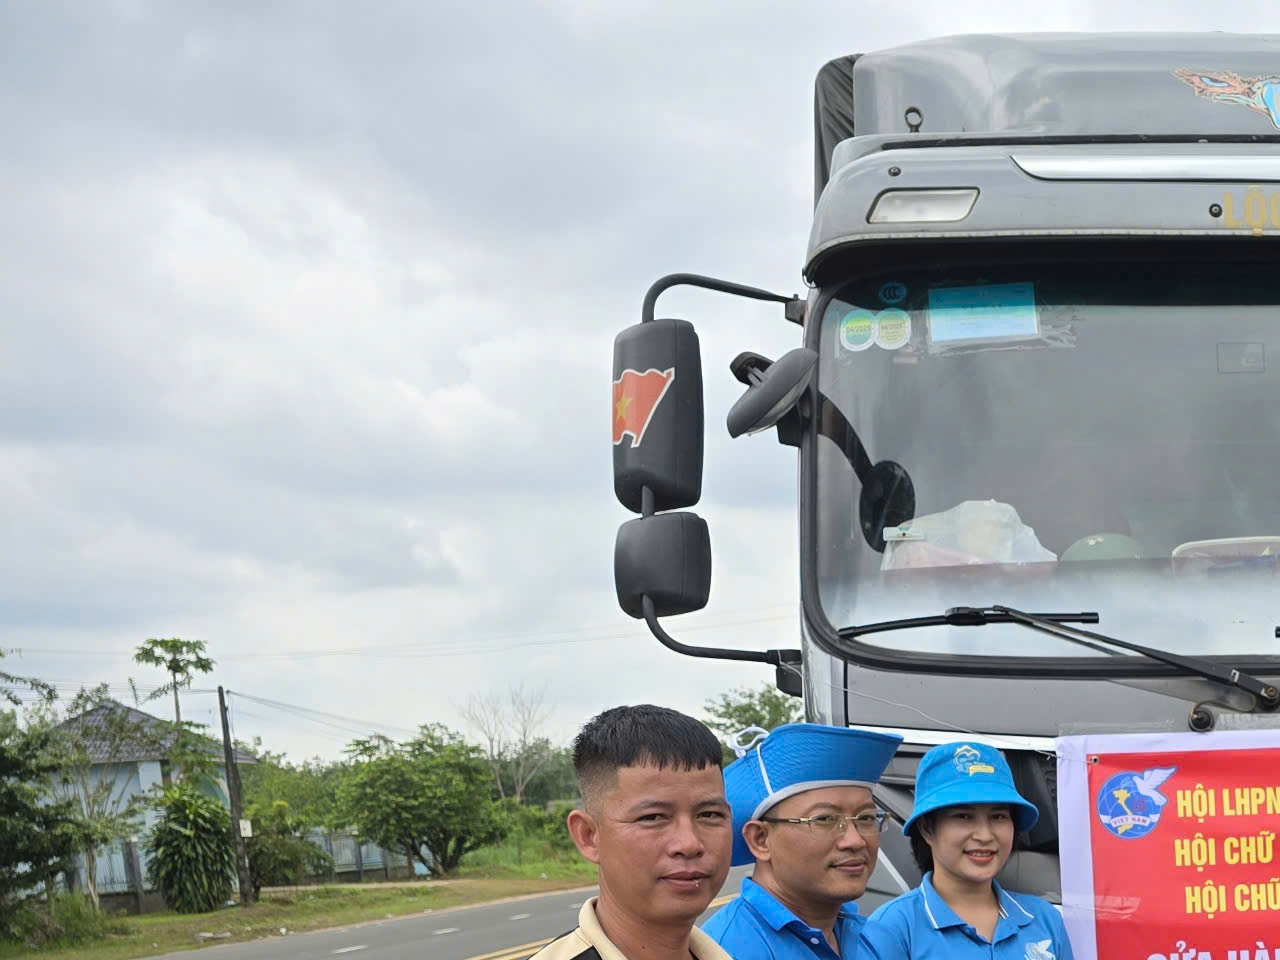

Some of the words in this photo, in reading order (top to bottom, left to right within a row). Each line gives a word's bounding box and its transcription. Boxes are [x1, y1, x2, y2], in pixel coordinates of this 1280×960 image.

[1176, 784, 1215, 822] HỘI
[1175, 833, 1216, 873] HỘI
[1224, 833, 1275, 864] CHỮ
[1185, 878, 1226, 919] HỘI
